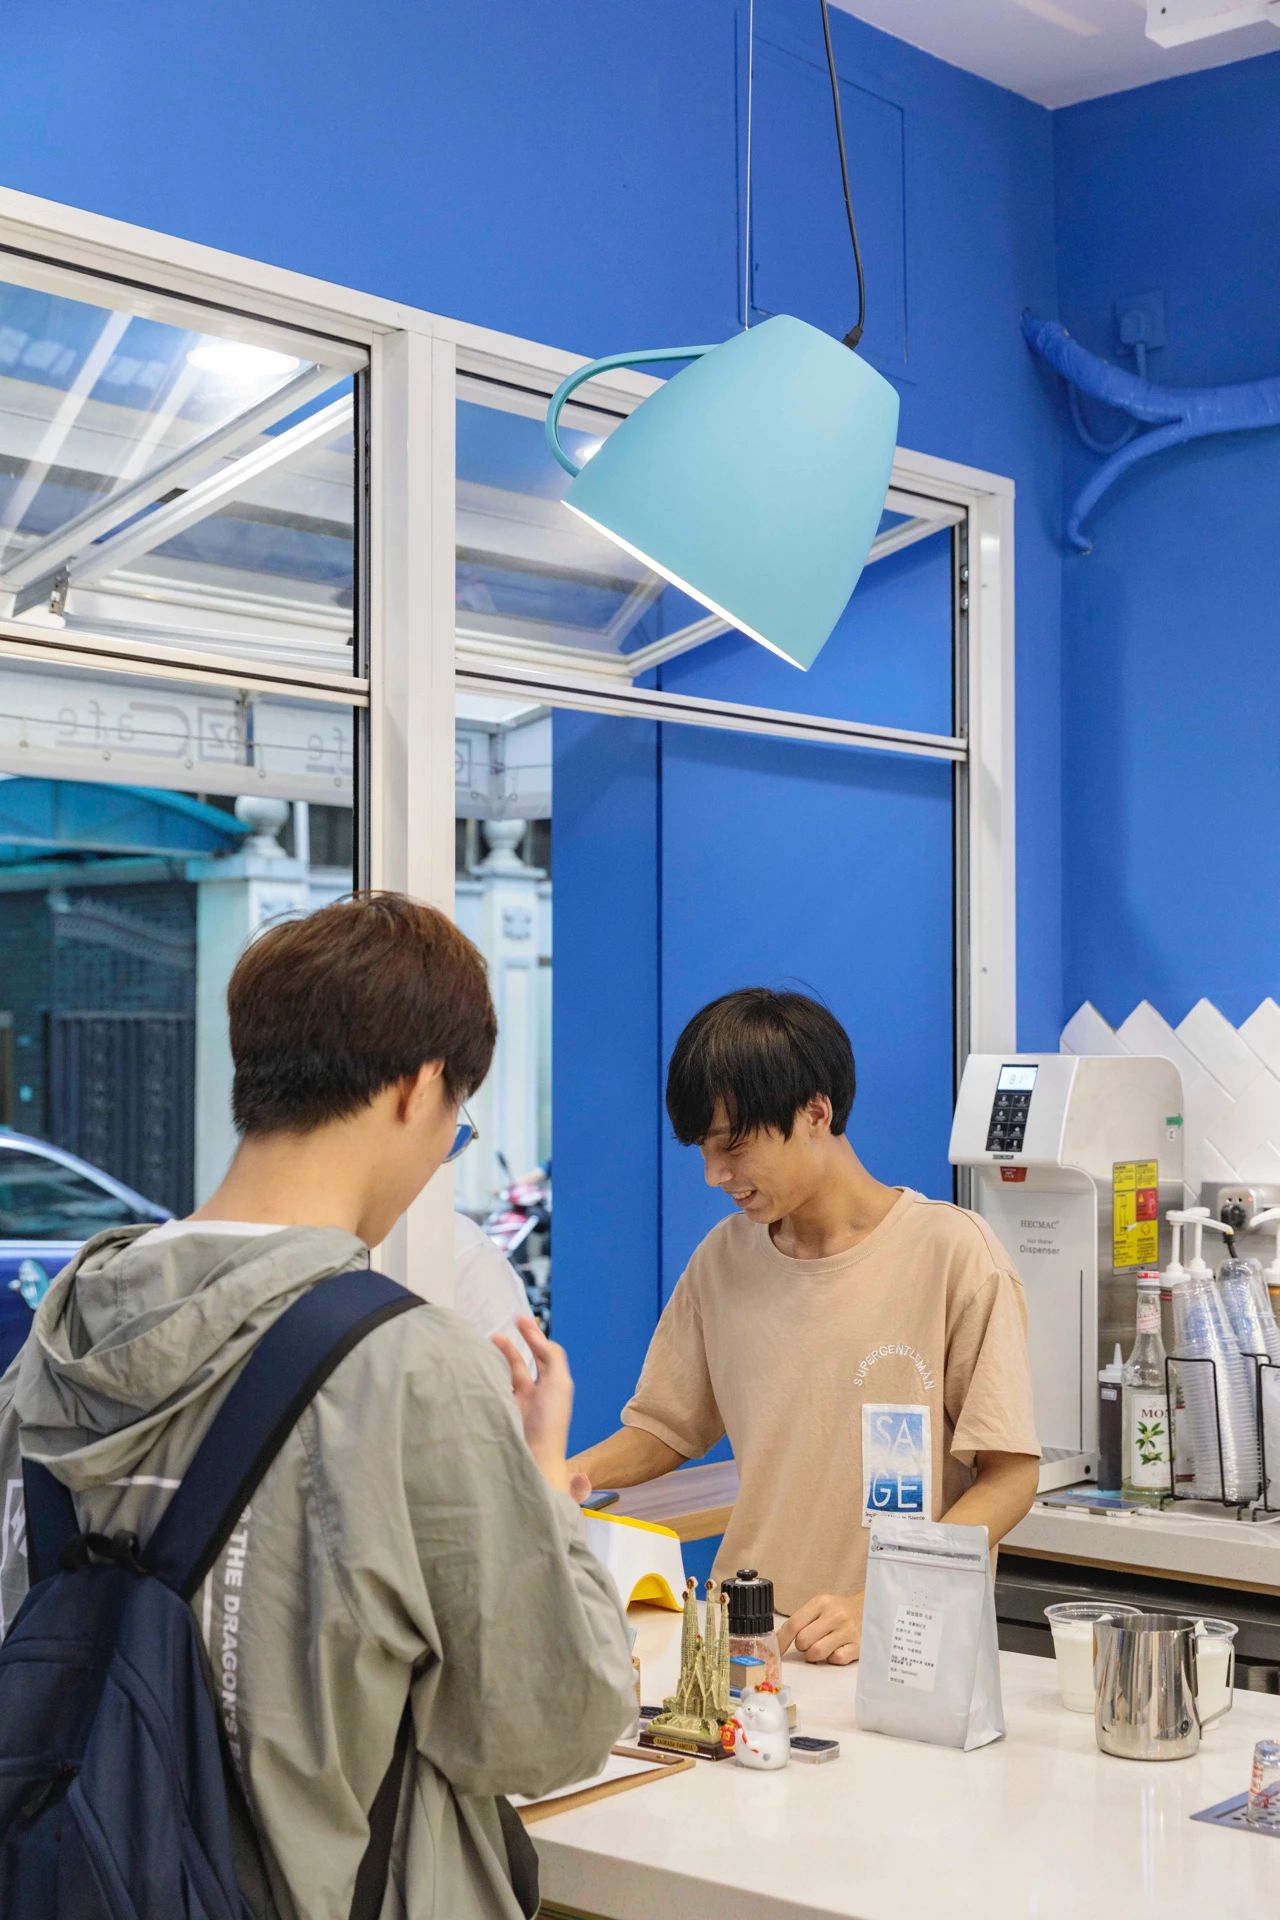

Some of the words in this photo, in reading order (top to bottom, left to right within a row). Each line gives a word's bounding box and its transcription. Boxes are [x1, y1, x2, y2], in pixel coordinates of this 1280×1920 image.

[1019, 1244, 1060, 1255] Dispenser
[853, 1344, 935, 1390] SUPERGENTLEMAN
[876, 1415, 919, 1461] SA
[872, 1469, 918, 1508] GE
[224, 1529, 248, 1587] THE
[221, 1594, 240, 1735] DRAGON'S
